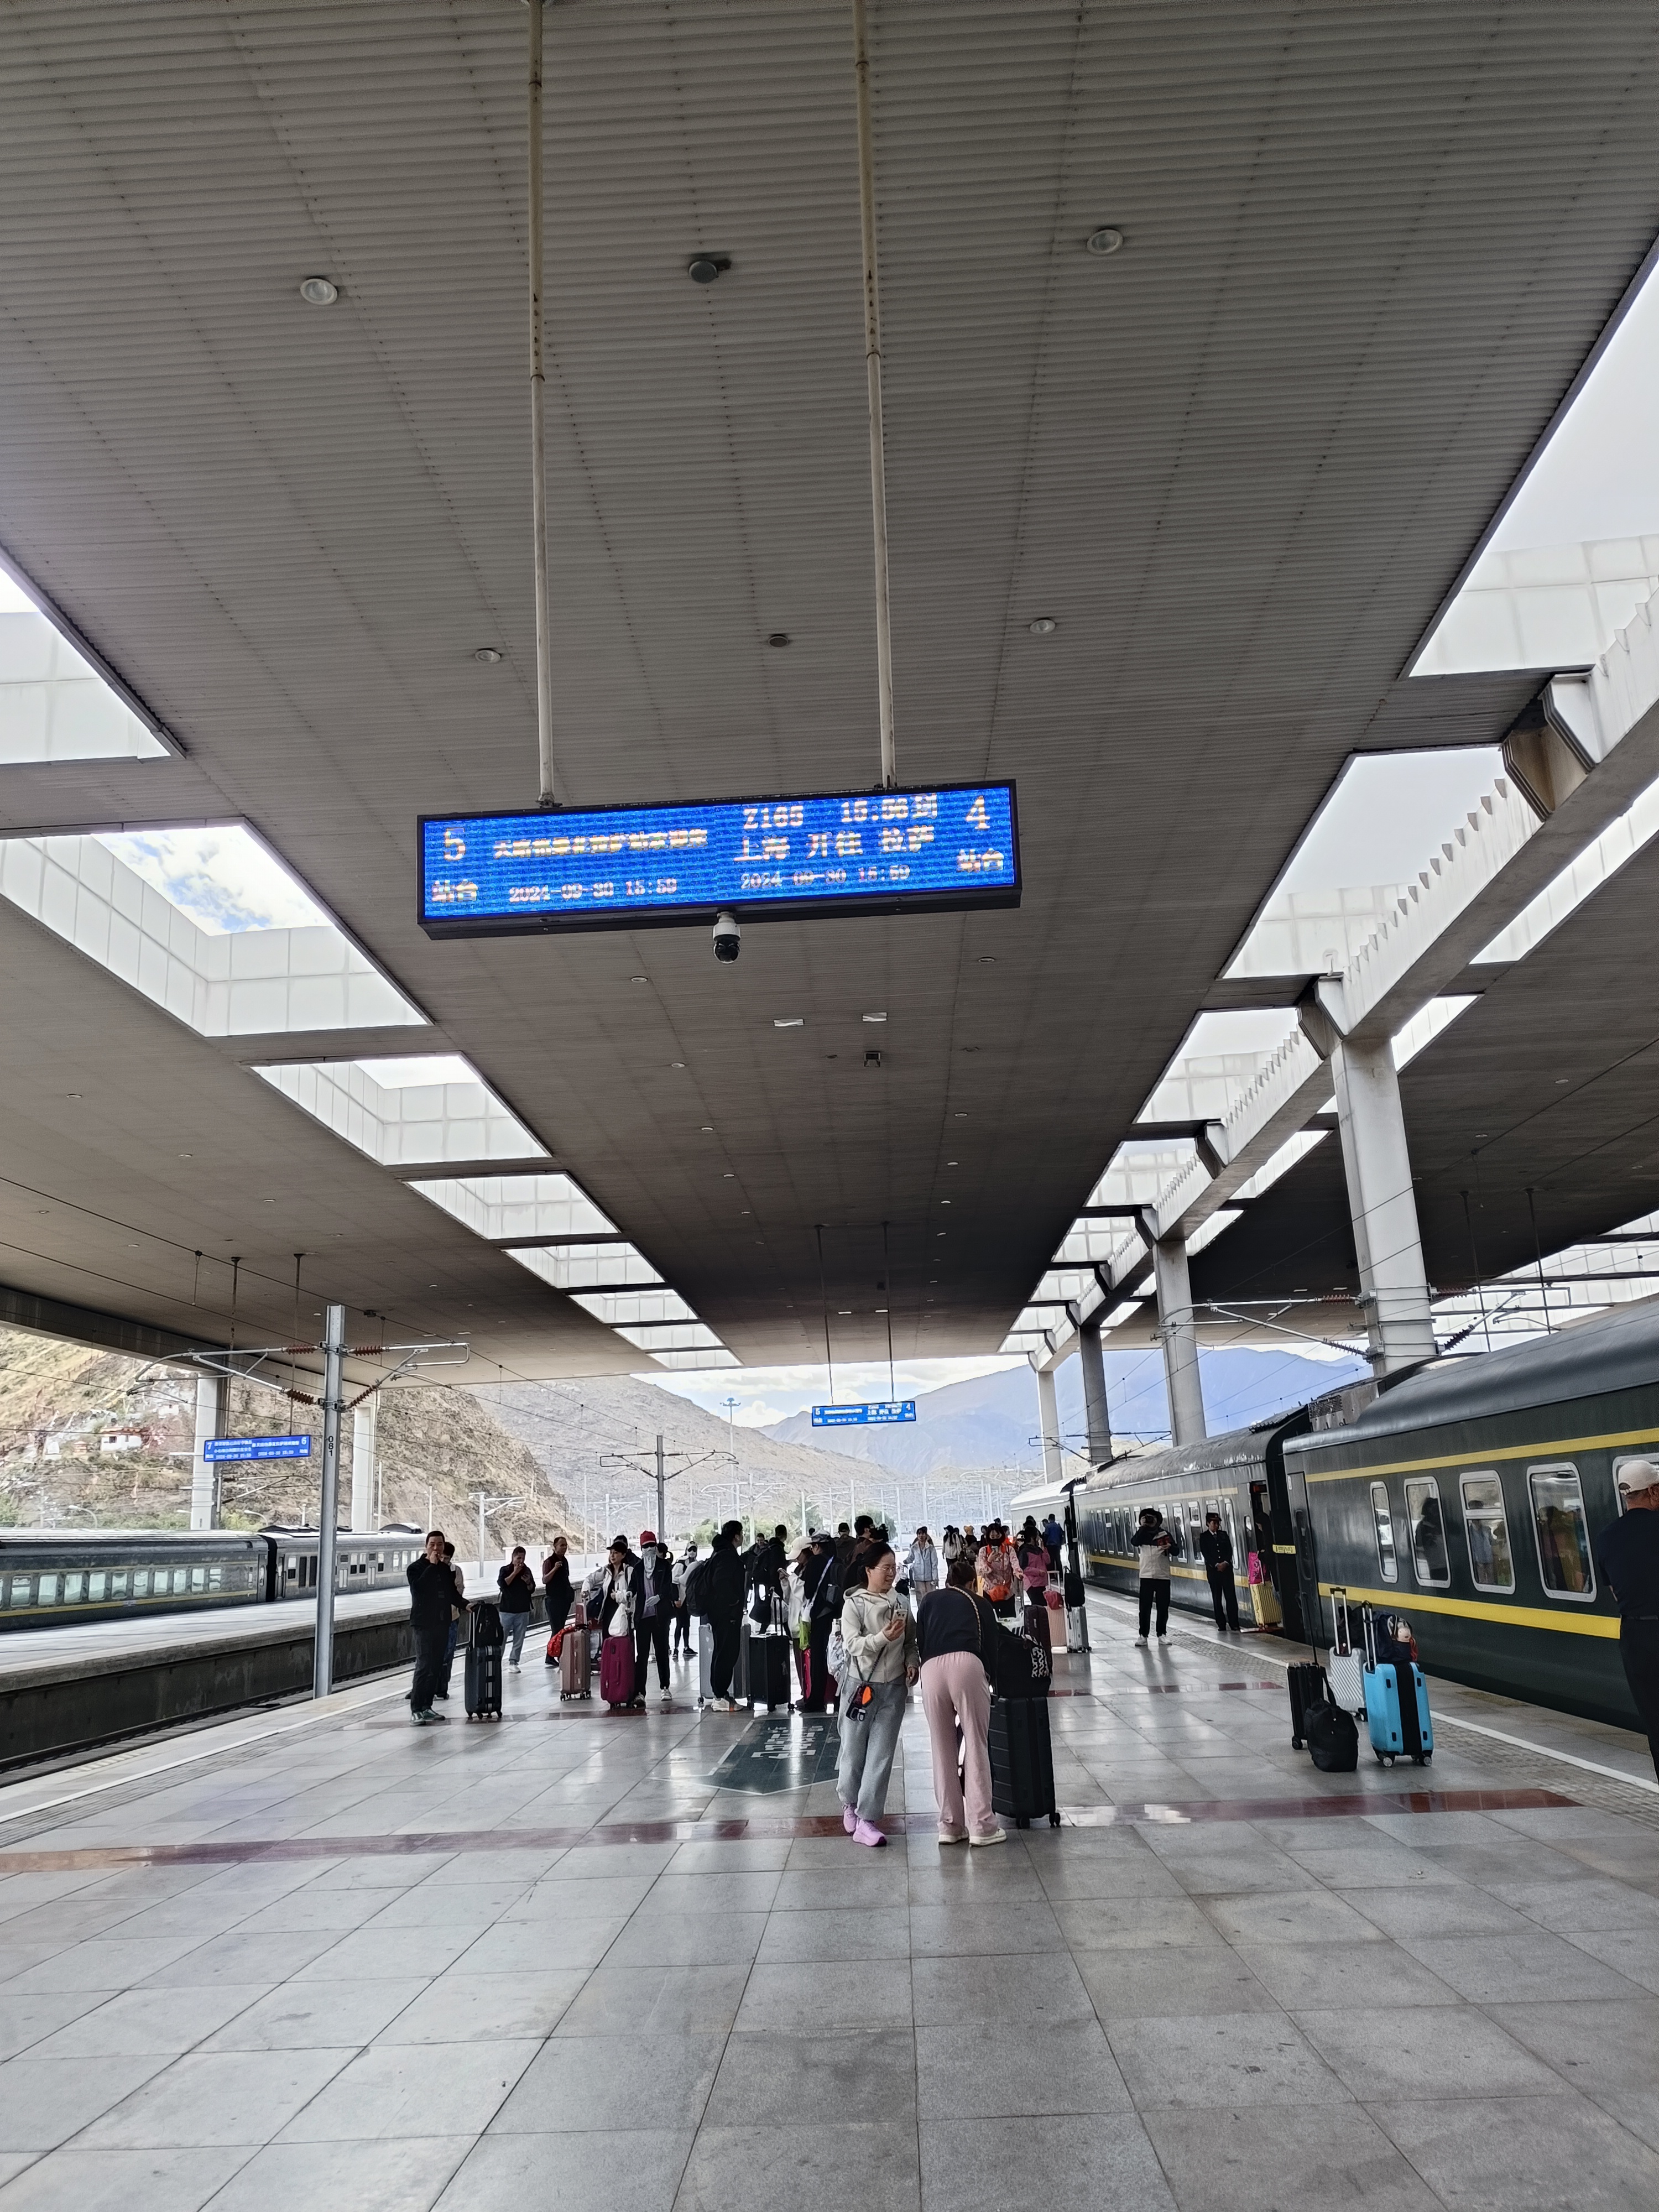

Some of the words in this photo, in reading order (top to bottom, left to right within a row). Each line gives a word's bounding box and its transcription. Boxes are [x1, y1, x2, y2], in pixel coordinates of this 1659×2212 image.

[744, 806, 804, 829] Z165
[965, 795, 990, 830] 4
[444, 827, 466, 861] 5
[734, 834, 790, 862] 上海
[806, 831, 863, 859] 开往
[878, 825, 935, 853] 拉萨
[956, 848, 1005, 873] 站台
[741, 868, 847, 889] 2024-09-30
[858, 865, 911, 883] 15:59
[431, 878, 478, 903] 站台
[509, 882, 614, 902] 2024-09-30
[625, 878, 677, 896] 15:59
